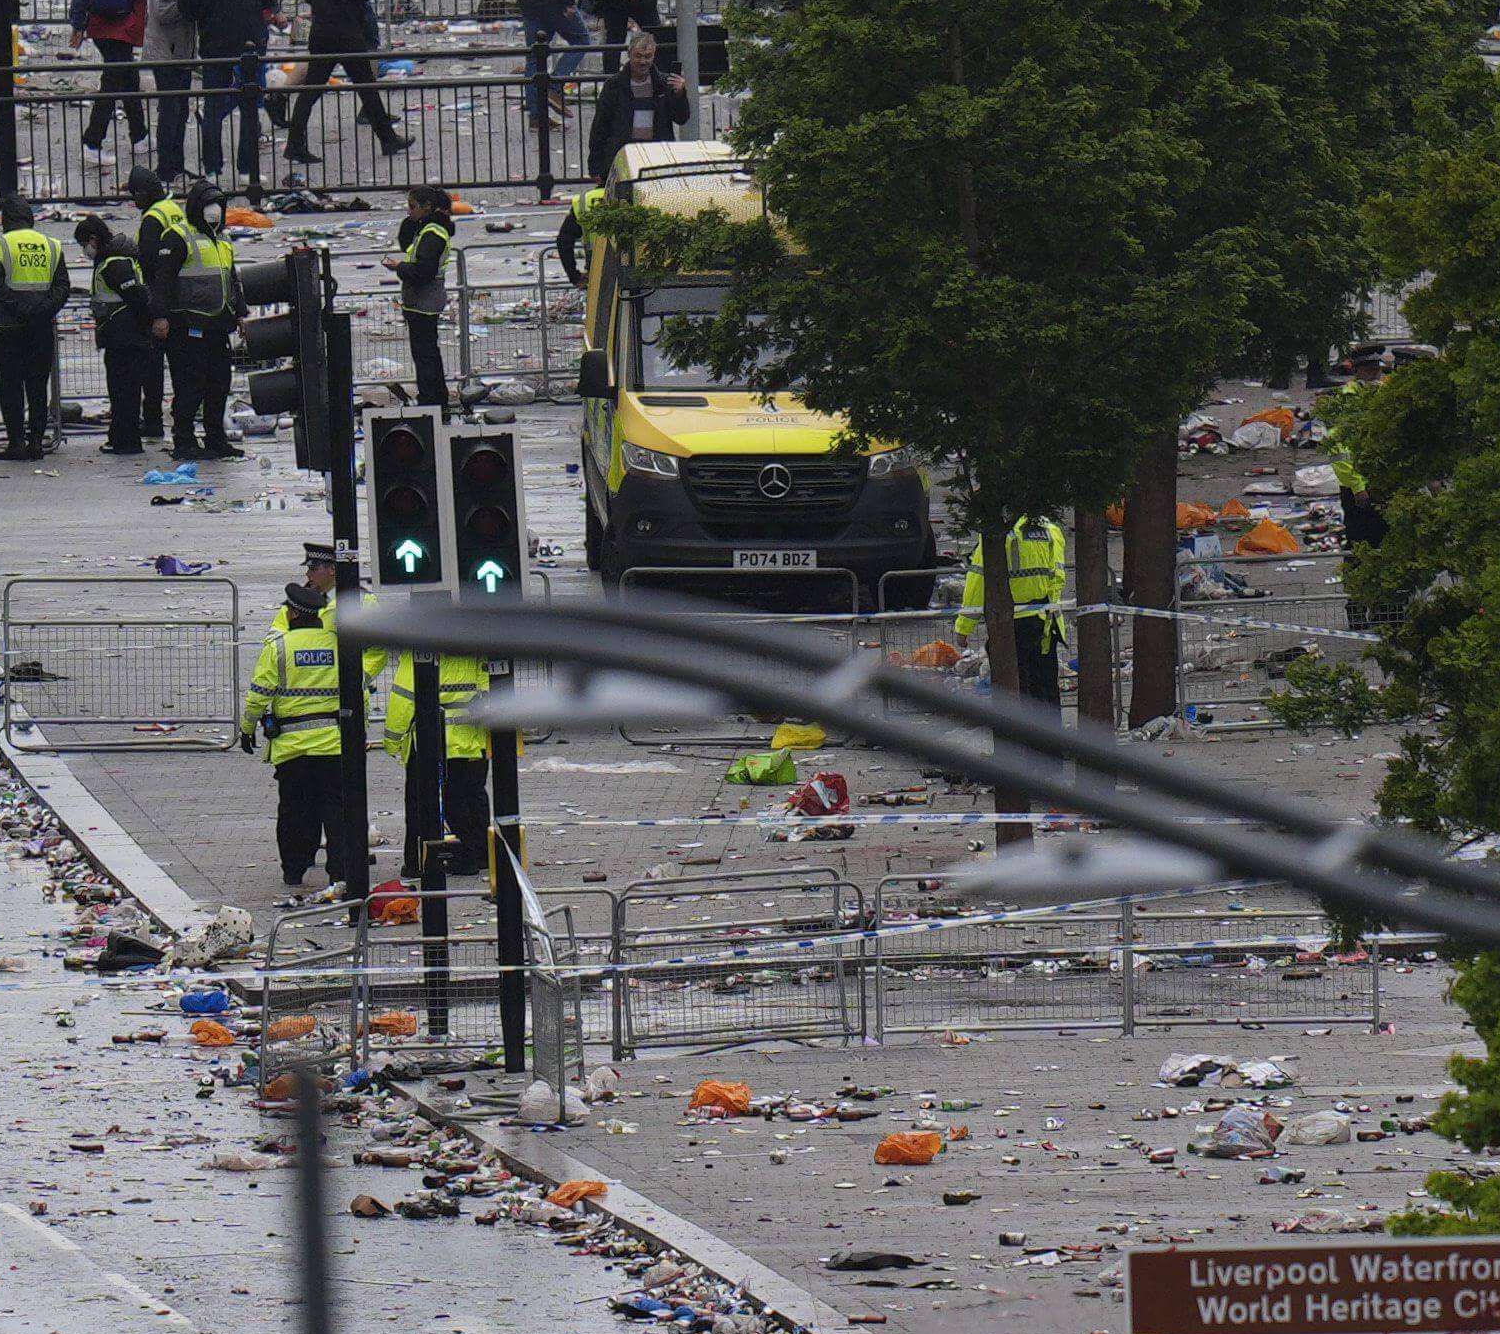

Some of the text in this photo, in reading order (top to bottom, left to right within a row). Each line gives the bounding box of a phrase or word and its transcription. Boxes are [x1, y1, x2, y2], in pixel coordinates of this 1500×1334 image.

[782, 551, 810, 566] BDZ
[296, 652, 333, 664] POLICE
[1190, 1256, 1340, 1293] Liverpool
[1198, 1293, 1292, 1324] World
[1305, 1290, 1442, 1328] Heritage
